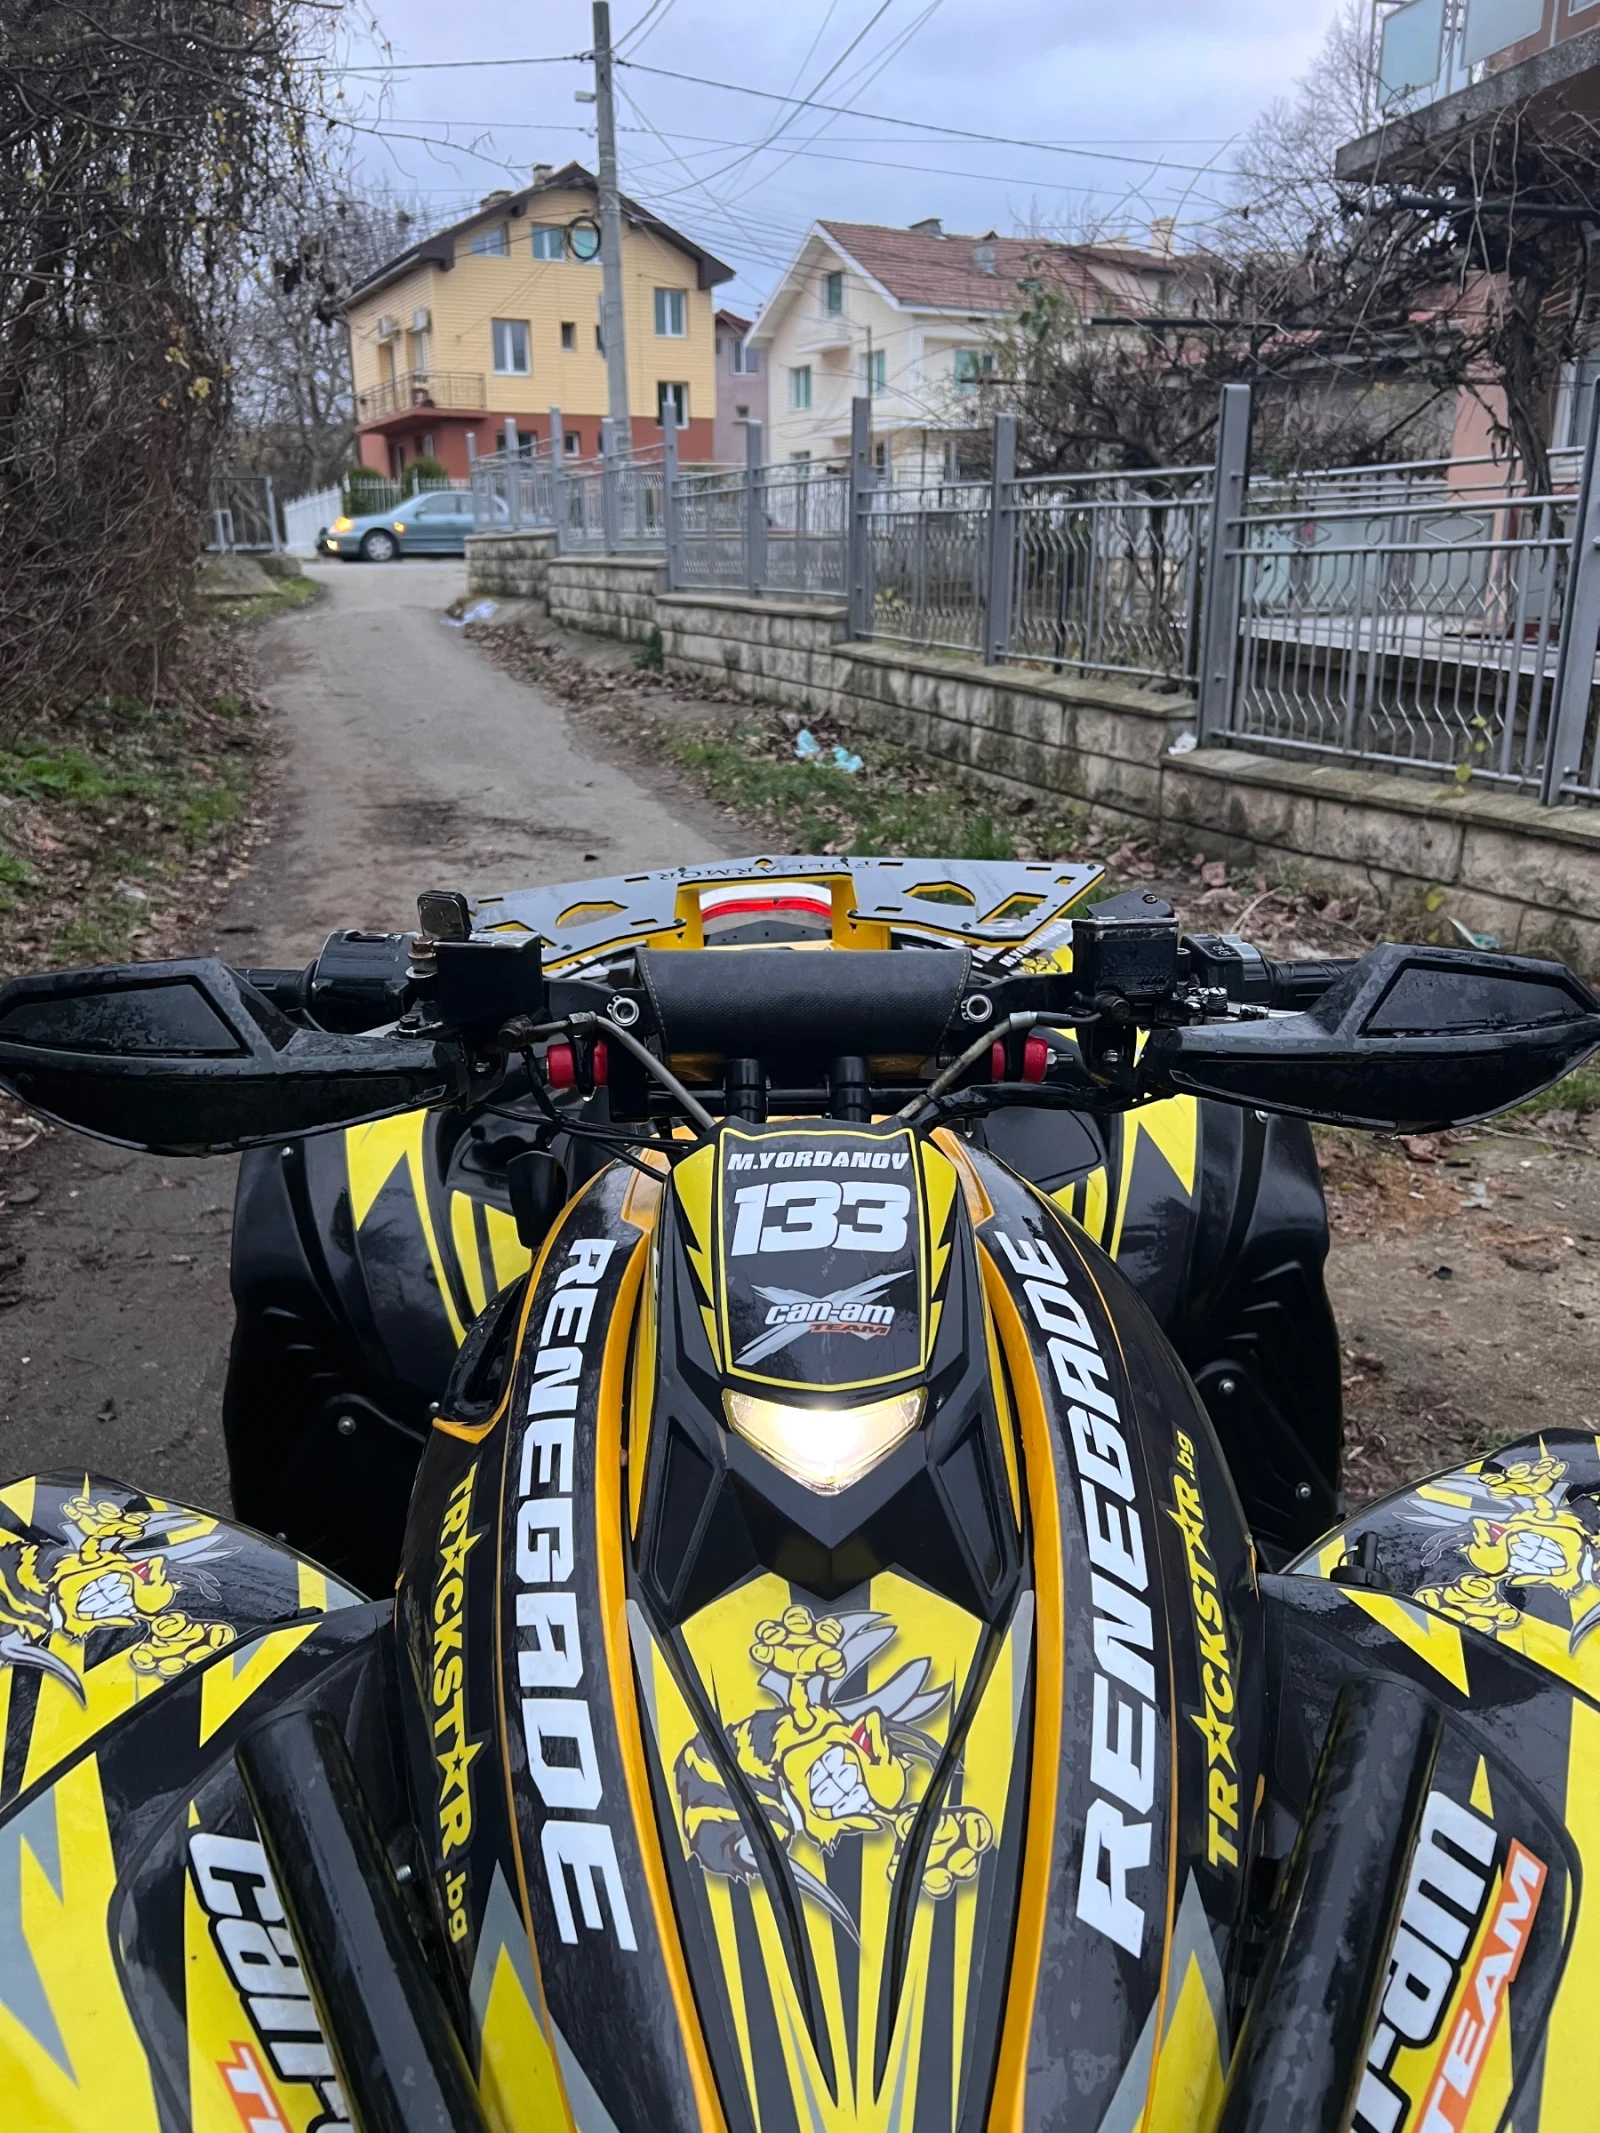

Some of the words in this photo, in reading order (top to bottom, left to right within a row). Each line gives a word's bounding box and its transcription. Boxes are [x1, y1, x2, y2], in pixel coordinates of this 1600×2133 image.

[656, 865, 778, 881] ARMOR
[787, 860, 873, 872] FULL
[727, 1151, 909, 1170] M.YORDANOV
[731, 1180, 911, 1256] 133
[765, 1302, 895, 1325] can-am
[811, 1324, 888, 1335] TEAM
[515, 1239, 639, 1952] RENEGADE
[993, 1231, 1156, 1960] RENEGADE
